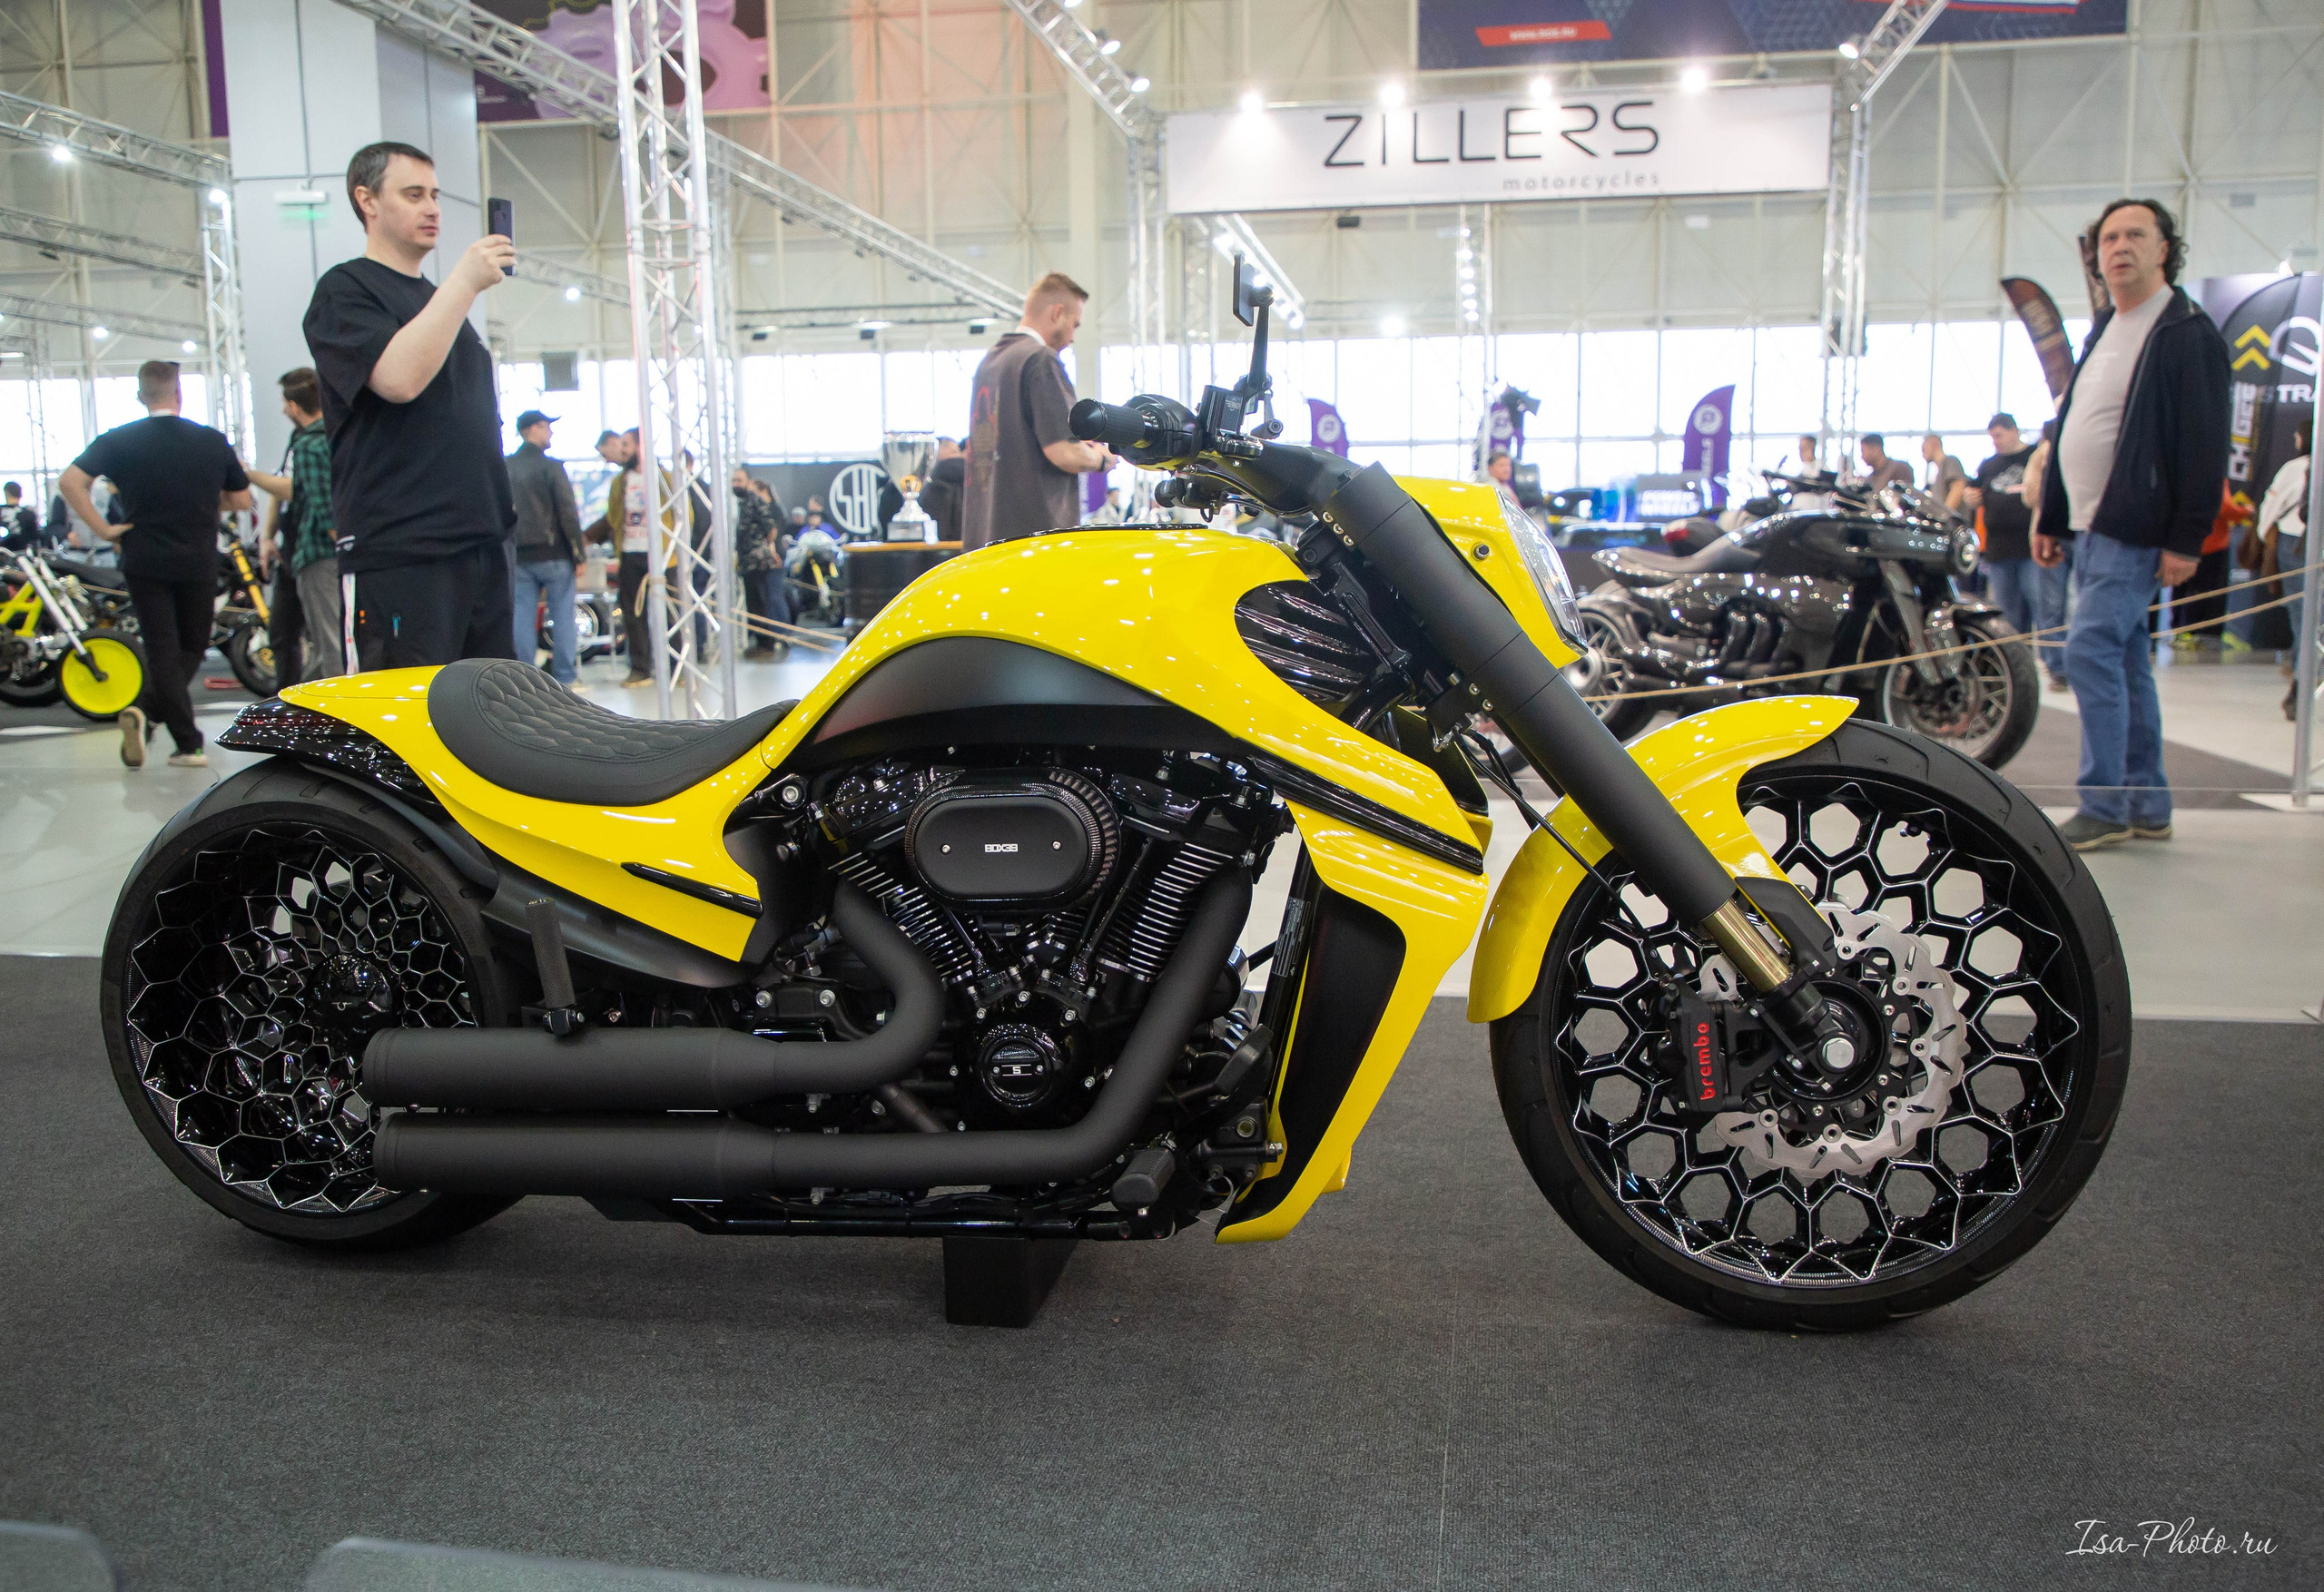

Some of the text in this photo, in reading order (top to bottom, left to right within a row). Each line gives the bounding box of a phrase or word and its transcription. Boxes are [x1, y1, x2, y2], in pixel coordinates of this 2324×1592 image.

[1324, 100, 1659, 167] ZILLERS
[1502, 171, 1661, 192] motorcycles
[1693, 1022, 1716, 1101] brembo
